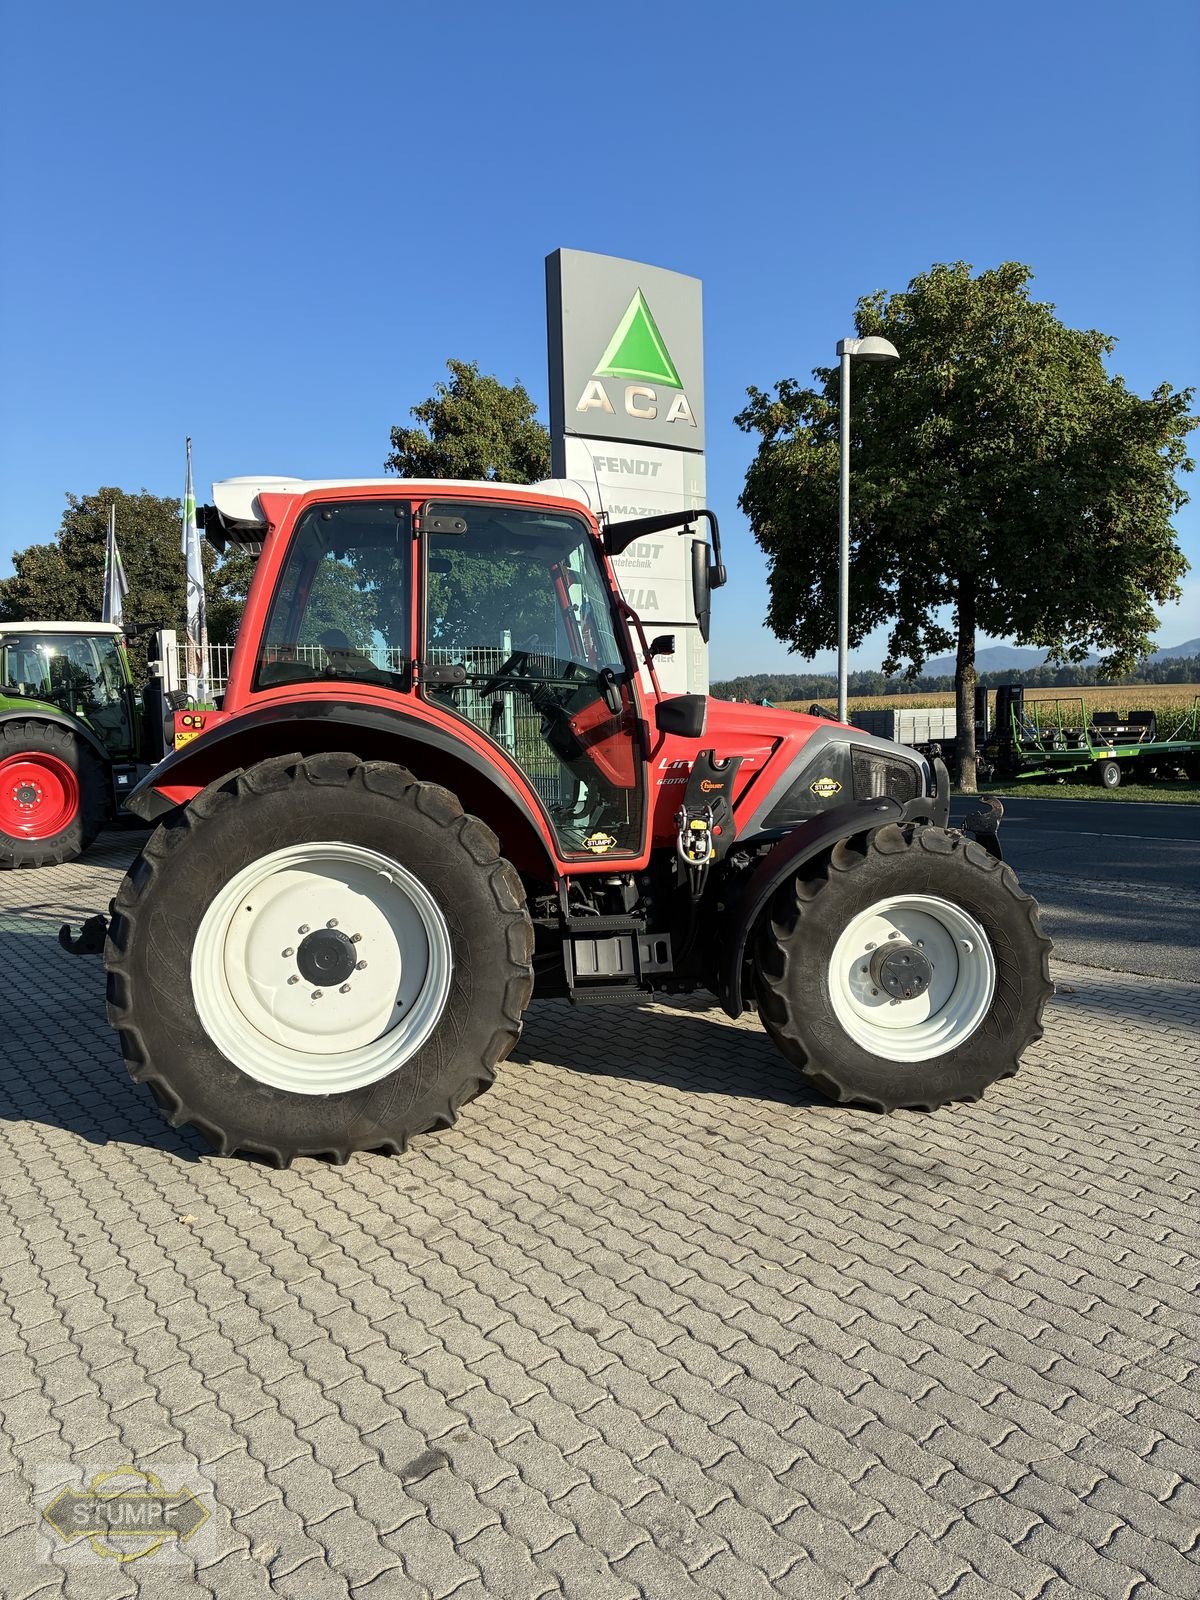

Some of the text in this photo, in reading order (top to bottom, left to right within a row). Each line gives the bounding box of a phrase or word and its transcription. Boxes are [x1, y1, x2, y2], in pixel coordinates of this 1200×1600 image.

[576, 380, 697, 428] ACA
[593, 456, 662, 477] FENDT
[608, 505, 675, 516] AMAZON
[622, 543, 664, 559] NDT
[613, 559, 652, 569] ntetechnik
[587, 839, 612, 847] STUMPF
